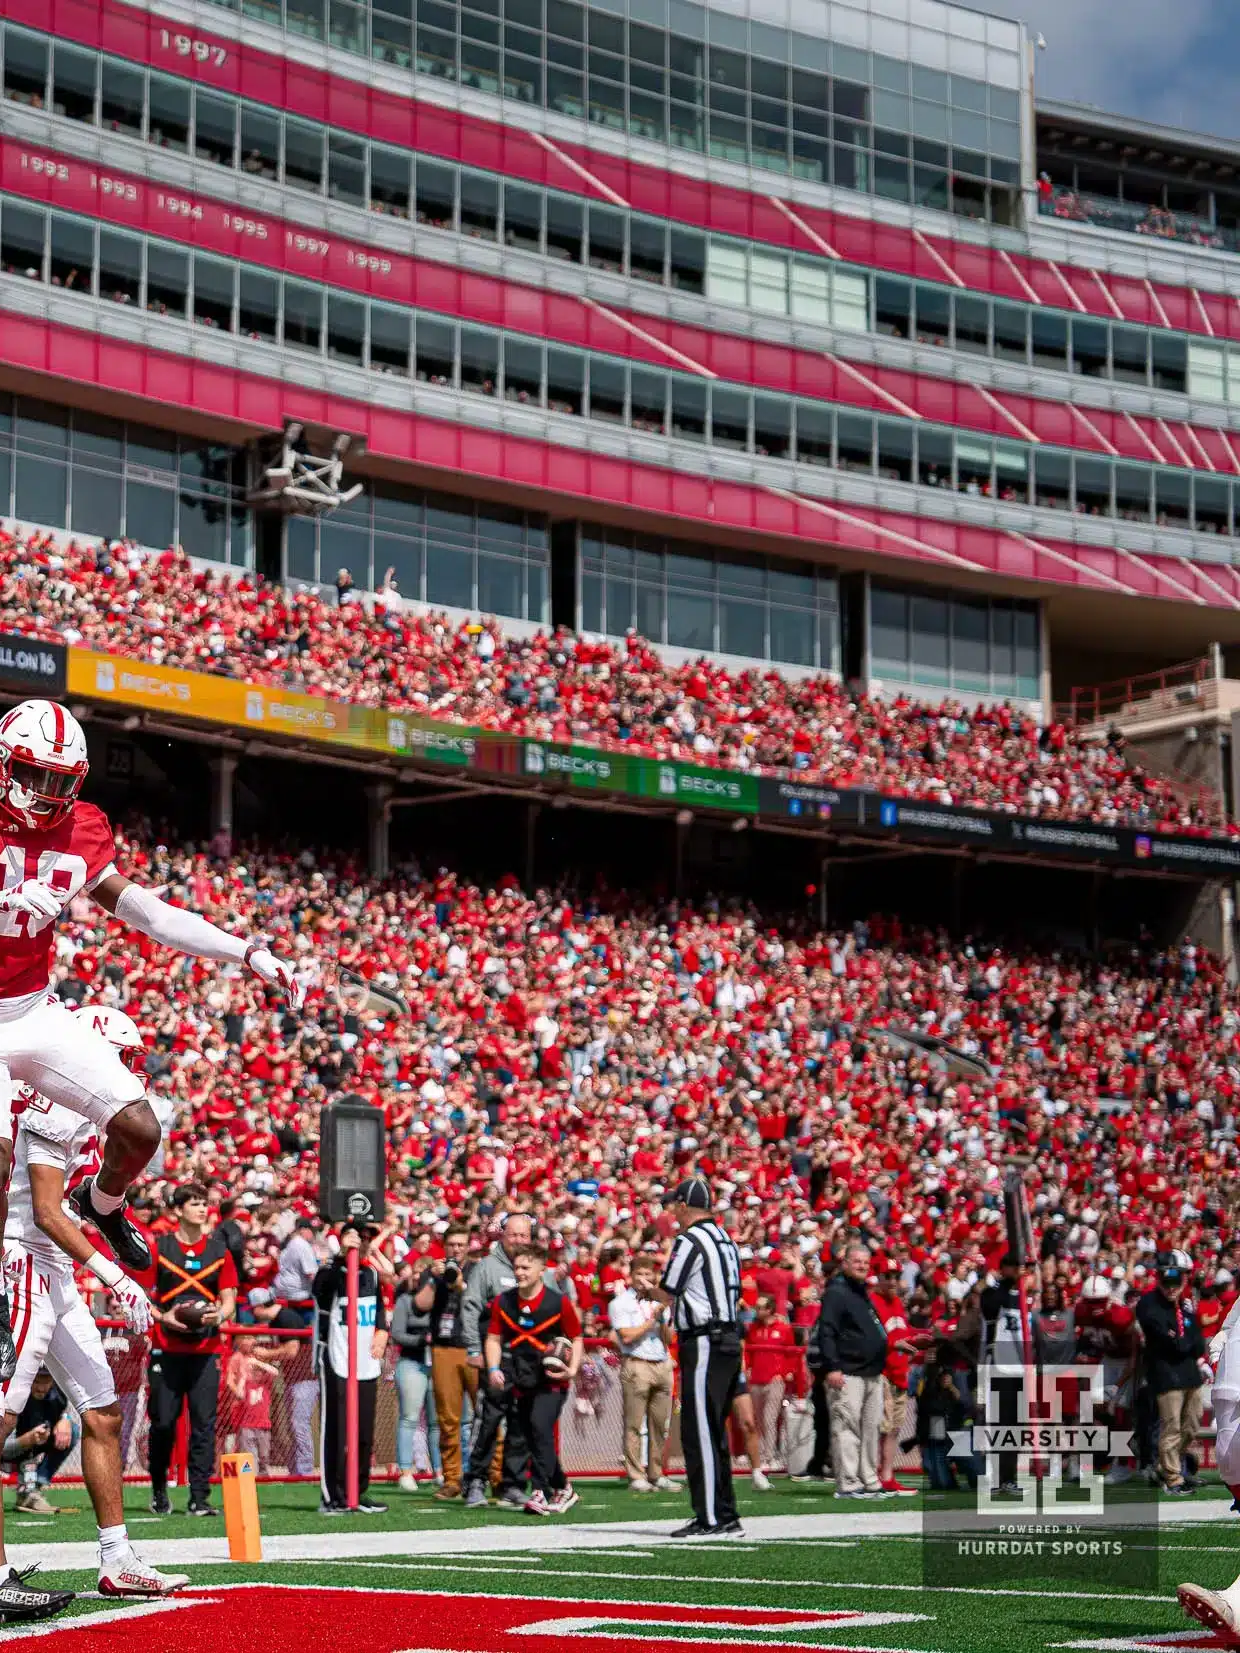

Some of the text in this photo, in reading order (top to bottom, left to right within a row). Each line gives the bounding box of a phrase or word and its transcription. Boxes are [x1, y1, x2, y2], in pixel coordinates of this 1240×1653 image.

[160, 29, 228, 67] 1997
[21, 153, 69, 181] 1992
[89, 173, 137, 201] 1993
[157, 194, 204, 220] 1994
[223, 213, 268, 240] 1995
[286, 231, 330, 256] 1997
[347, 249, 391, 274] 1999
[15, 653, 39, 671] ON
[39, 653, 56, 675] 16
[120, 671, 191, 701] BECK'S
[411, 729, 476, 756] BECK'S
[547, 752, 611, 778] BECK'S
[678, 774, 742, 799] BECK'S
[39, 1273, 51, 1295] N
[222, 1462, 238, 1478] N
